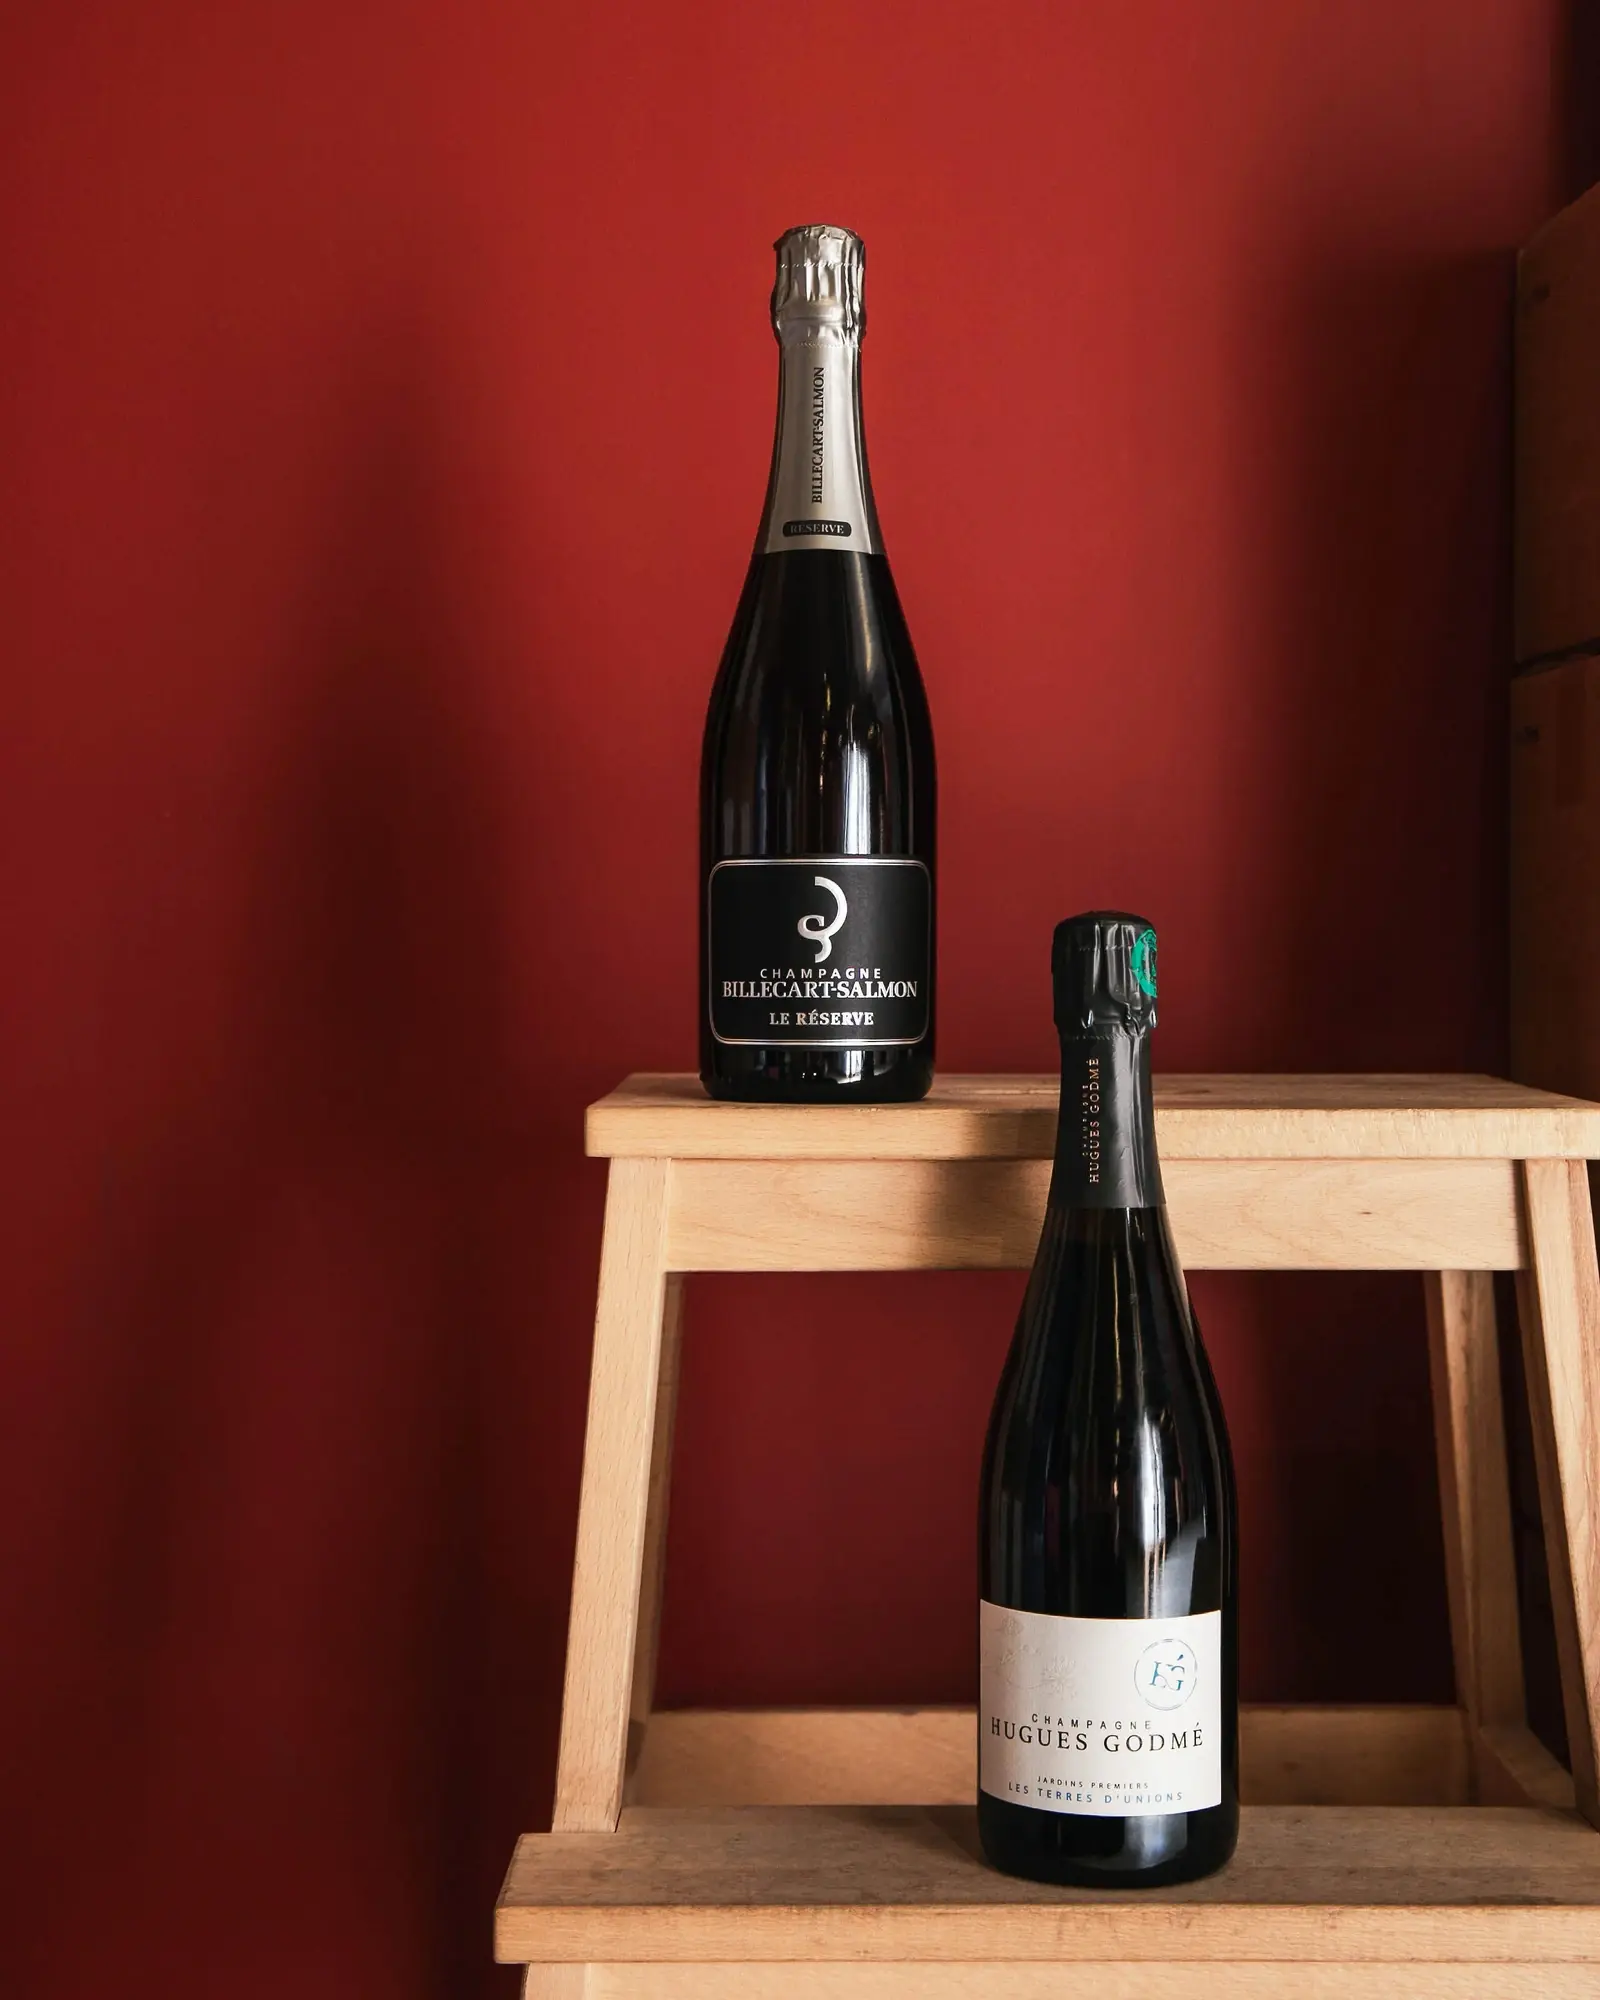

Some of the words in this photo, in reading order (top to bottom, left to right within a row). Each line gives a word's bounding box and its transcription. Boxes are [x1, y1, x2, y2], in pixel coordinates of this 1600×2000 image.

[812, 366, 824, 504] BILLECART-SALMON
[760, 968, 881, 979] CHAMPAGNE
[722, 981, 918, 998] BILLECART-SALMON
[769, 1012, 789, 1025] LE
[796, 1009, 874, 1026] RÉSERVE
[1086, 1057, 1099, 1113] GODMÉ
[1089, 1120, 1099, 1183] HUGUES
[1031, 1713, 1151, 1730] CHAMPAGNE
[991, 1716, 1088, 1751] HUGUES
[1103, 1722, 1203, 1752] GODMÉ
[1037, 1776, 1083, 1788] JARDINS
[1091, 1782, 1149, 1790] PREMIERS
[1008, 1782, 1029, 1794] LES
[1038, 1788, 1092, 1803] TERRES
[1104, 1792, 1183, 1804] D'UNIONS
